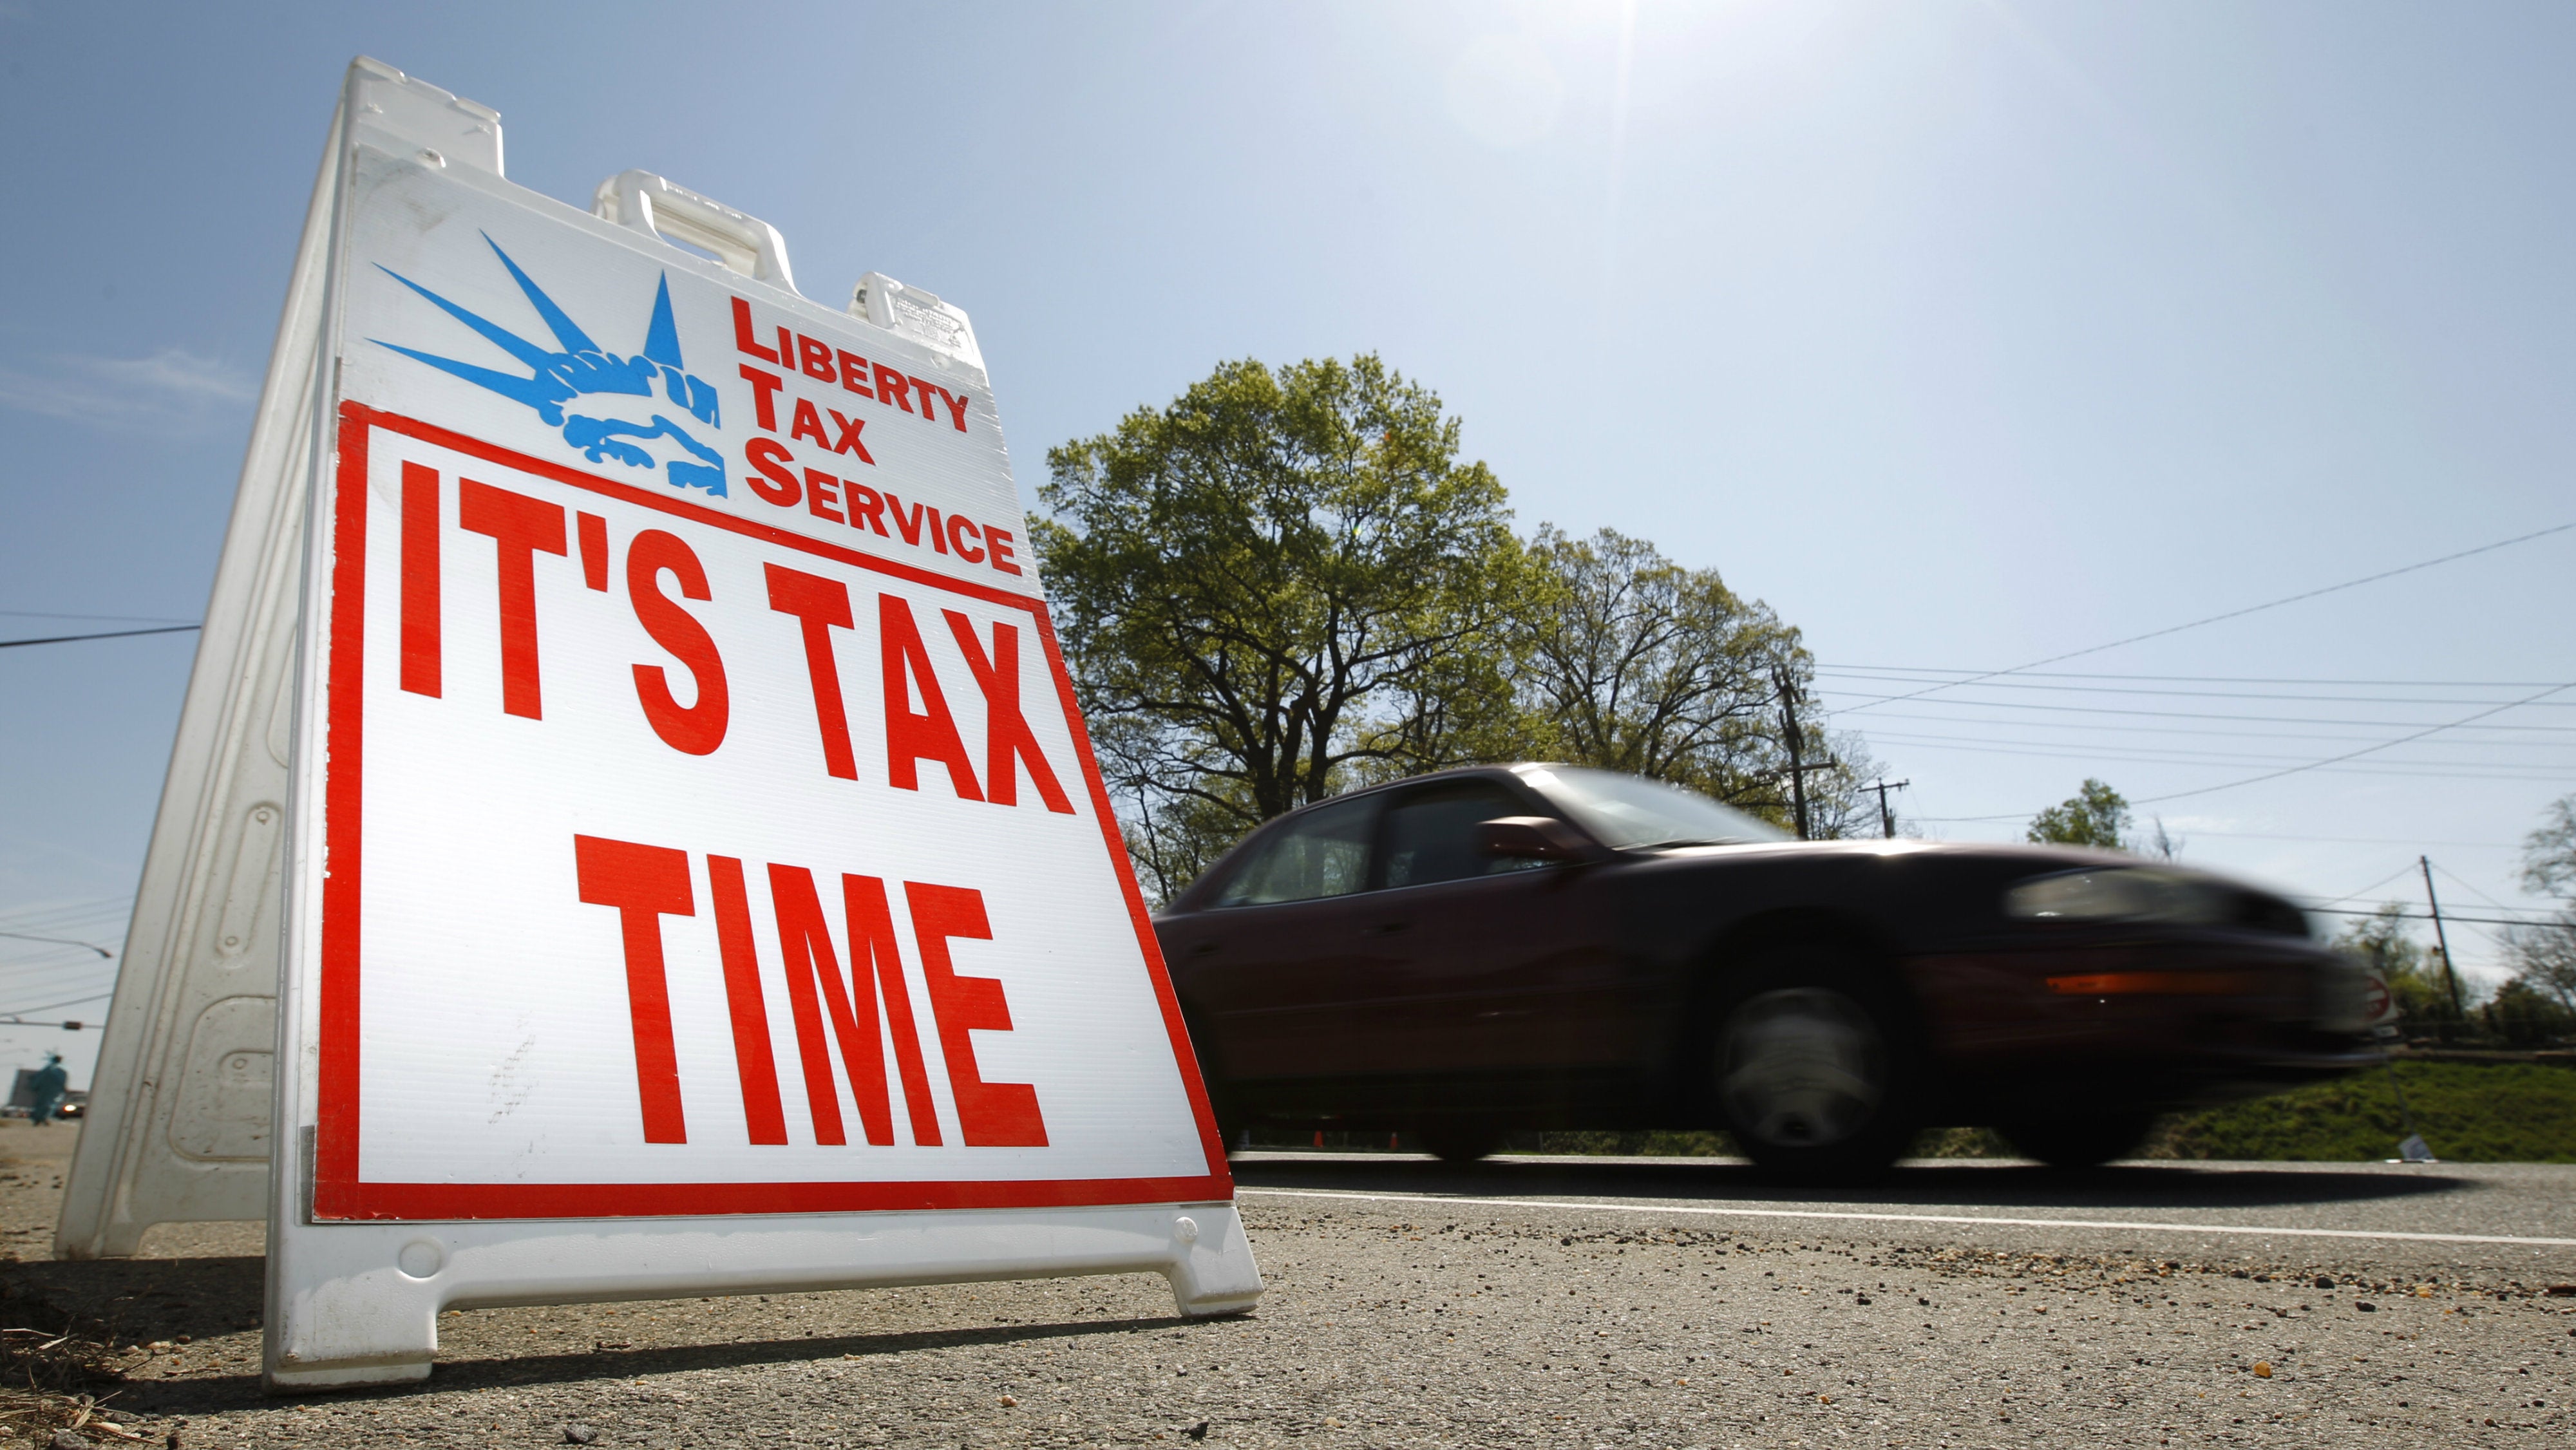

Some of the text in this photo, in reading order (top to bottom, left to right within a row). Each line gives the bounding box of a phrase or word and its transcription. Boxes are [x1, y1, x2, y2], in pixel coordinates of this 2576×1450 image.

[732, 297, 968, 432] LIBERTY
[739, 364, 875, 465] TAX
[745, 438, 1021, 576] SERVICE
[401, 460, 1075, 814] IT'S TAX
[574, 834, 1049, 1147] TIME
